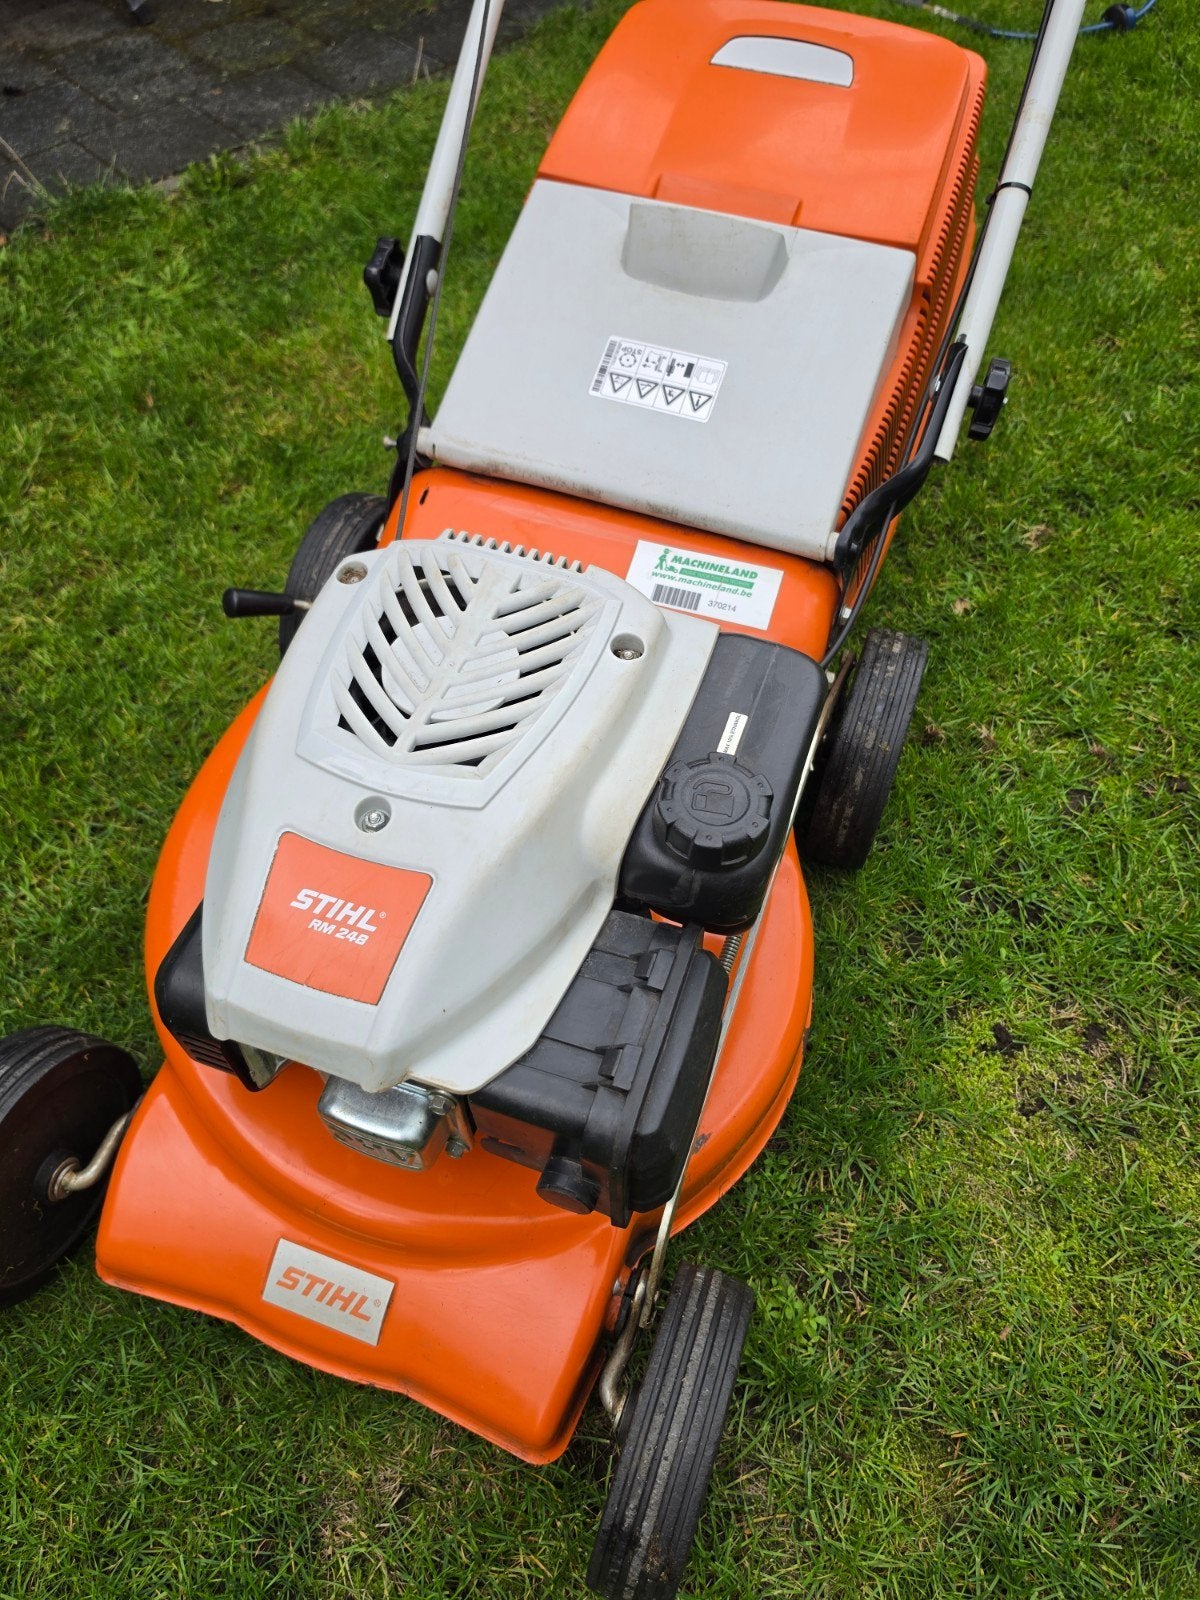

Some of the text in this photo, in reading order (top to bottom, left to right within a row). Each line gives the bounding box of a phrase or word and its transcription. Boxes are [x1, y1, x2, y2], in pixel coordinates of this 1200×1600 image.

[621, 346, 643, 355] STOP
[671, 555, 758, 580] MACHINELAND
[651, 571, 753, 598] www.machineland.be
[707, 600, 737, 612] 370214
[290, 888, 378, 932] STIHL
[308, 918, 369, 945] RM 248
[276, 1266, 372, 1322] STIHL
